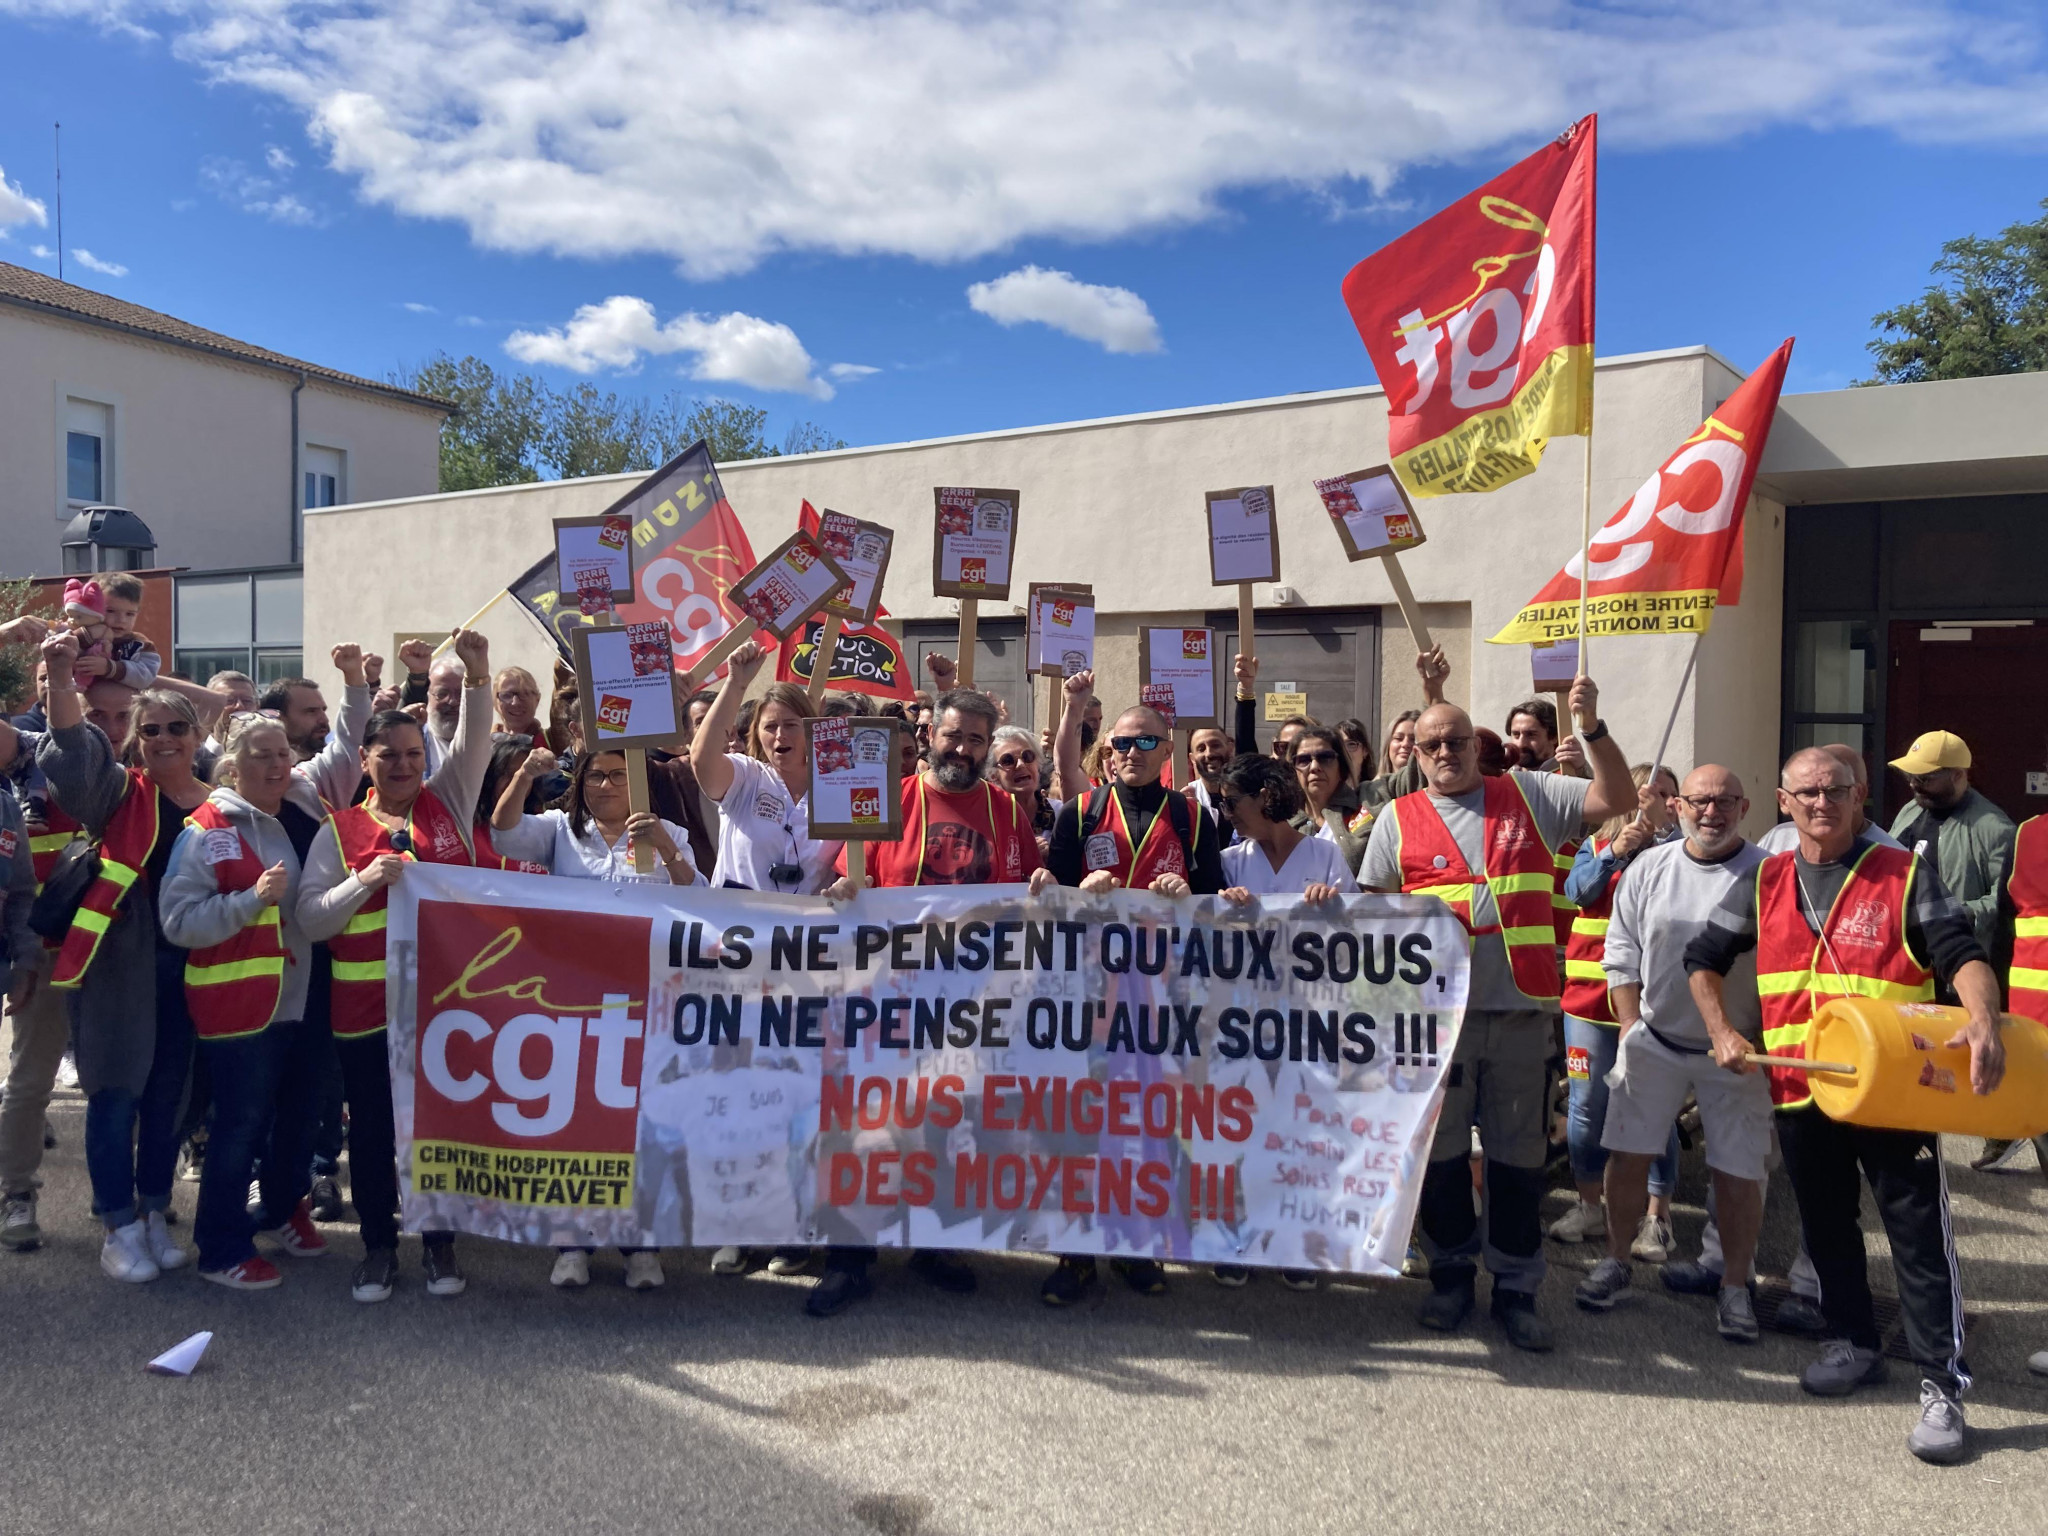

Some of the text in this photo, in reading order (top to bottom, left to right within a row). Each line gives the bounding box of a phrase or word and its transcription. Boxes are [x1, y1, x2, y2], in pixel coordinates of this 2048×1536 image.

[600, 525, 628, 545] cgt
[1387, 521, 1412, 537] cgt
[790, 545, 816, 569] cgt
[961, 566, 986, 582] cgt
[1054, 605, 1074, 622] cgt
[1183, 637, 1207, 654] cgt
[632, 675, 665, 683] permanent
[634, 681, 668, 689] permanent
[600, 705, 630, 724] cgt
[852, 797, 879, 816] cgt
[668, 920, 754, 970] ILS
[770, 923, 839, 971] NE
[855, 919, 1086, 972] PENSENT
[1098, 922, 1277, 982] QU'AUX
[1291, 930, 1447, 994] SOUS,
[433, 925, 644, 1012] la
[672, 992, 1438, 1068] ON NE PENSE QU'AUX SOINS !!!
[421, 993, 644, 1137] cgt
[1568, 1055, 1588, 1072] cgt
[704, 1096, 729, 1118] JE
[818, 1074, 1255, 1143] NOUS EXIGEONS
[1351, 1116, 1400, 1146] QUE
[418, 1144, 631, 1178] CENTRE HOSPITALIER
[419, 1166, 629, 1206] DE MONTFAVET
[828, 1151, 1238, 1223] DES MOYENS !!!
